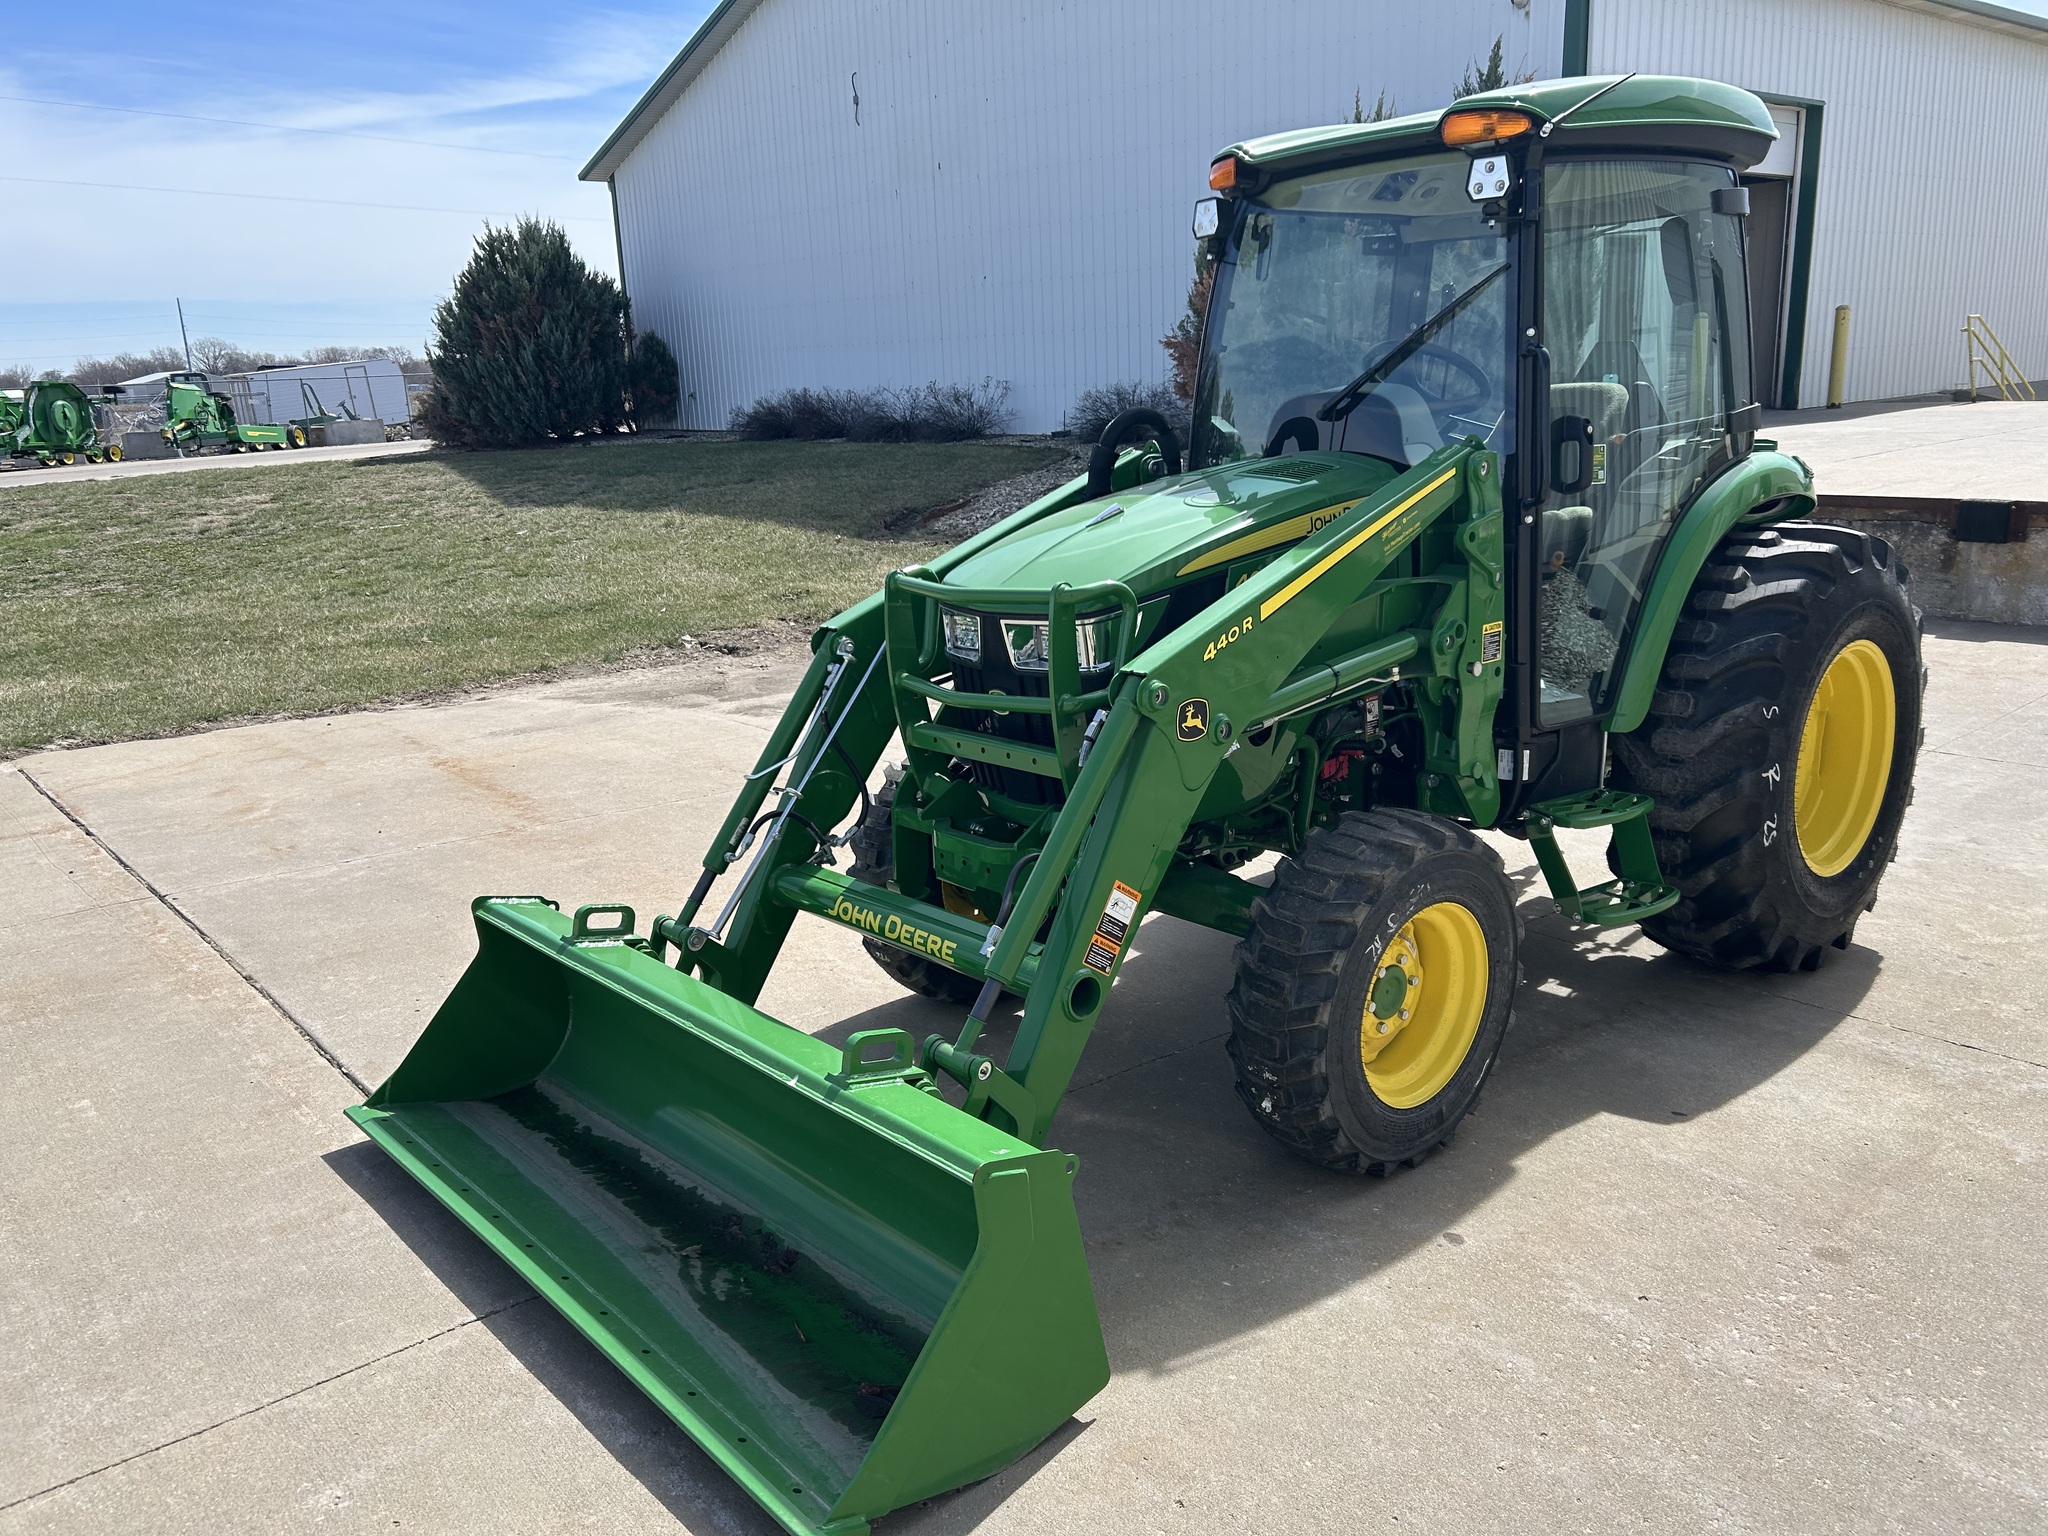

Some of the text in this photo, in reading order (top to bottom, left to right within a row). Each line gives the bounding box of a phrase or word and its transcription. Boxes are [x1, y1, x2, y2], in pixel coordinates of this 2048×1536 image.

[1203, 616, 1253, 662] 440 R
[827, 896, 958, 963] JOHN DEERE
